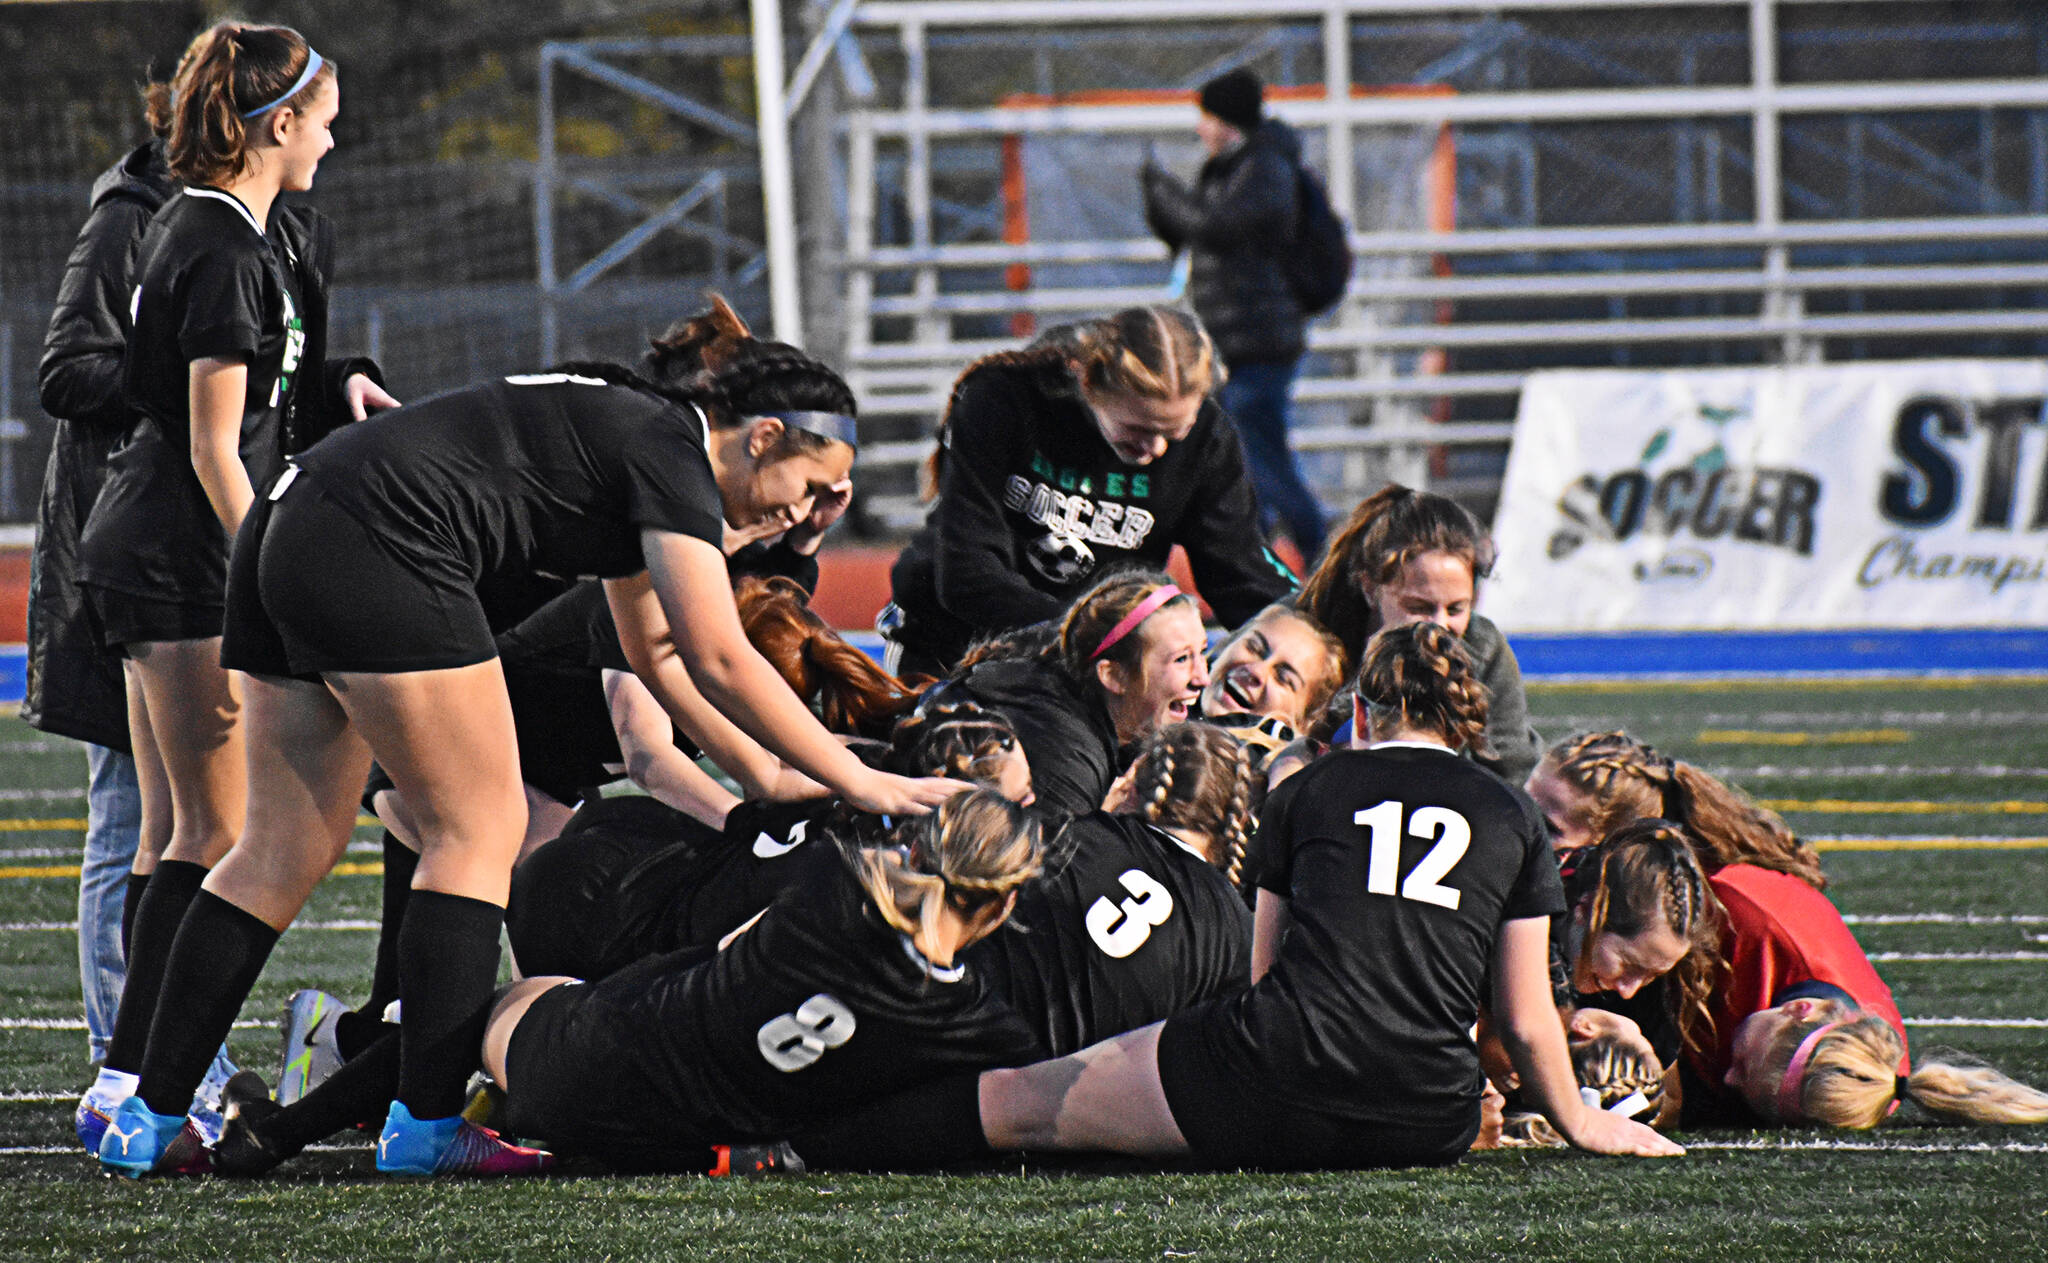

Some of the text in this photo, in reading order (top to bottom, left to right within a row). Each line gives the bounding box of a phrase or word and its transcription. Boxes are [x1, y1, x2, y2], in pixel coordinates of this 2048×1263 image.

[1880, 394, 2048, 530] ST
[1004, 474, 1155, 550] SOCCER
[1547, 465, 1821, 559] SOCCER
[1353, 800, 1471, 911] 12
[1085, 868, 1173, 958] 3
[757, 993, 857, 1072] 8
